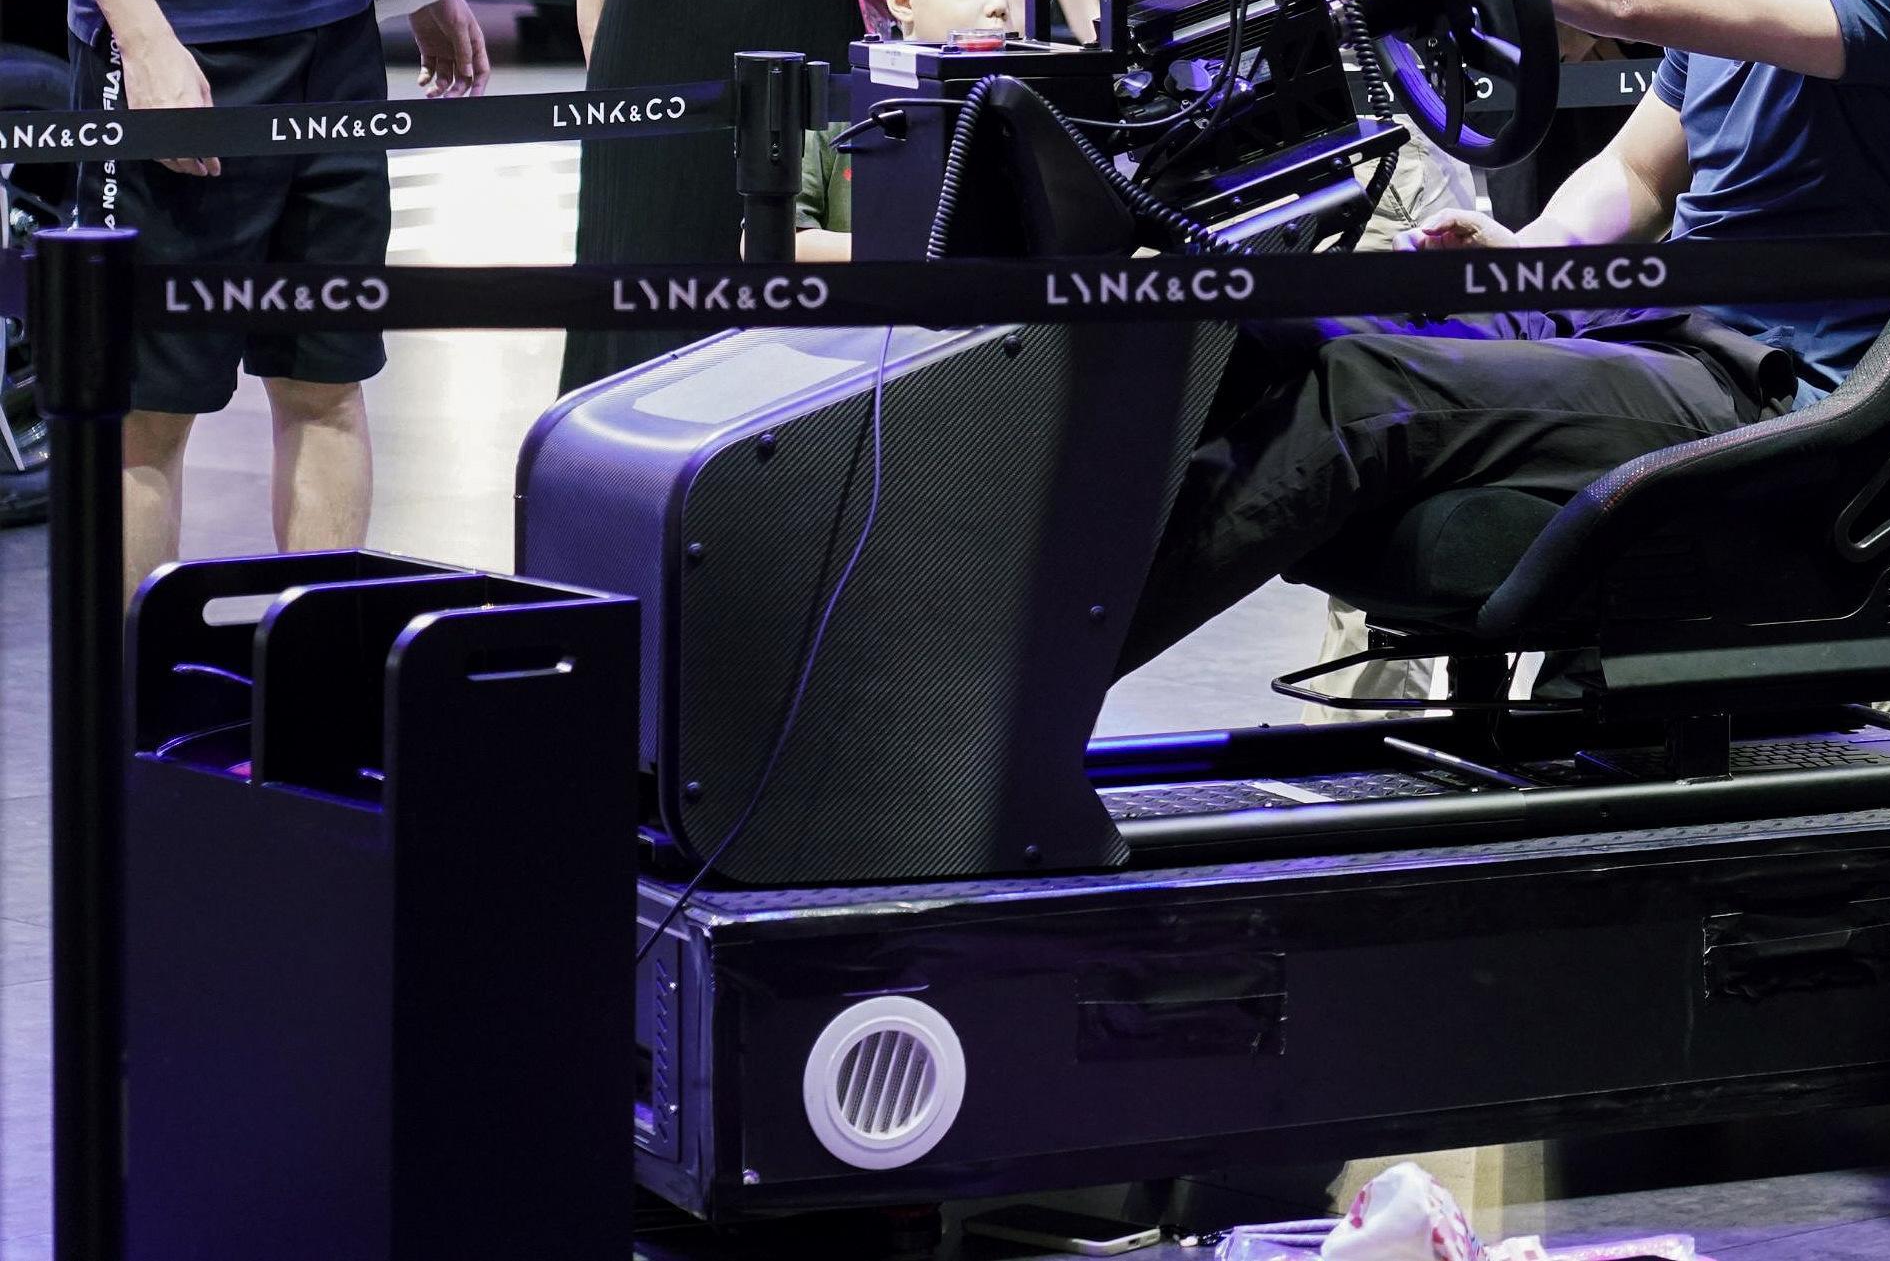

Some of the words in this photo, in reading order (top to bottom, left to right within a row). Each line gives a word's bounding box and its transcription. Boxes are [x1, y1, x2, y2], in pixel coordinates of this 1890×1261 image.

[272, 111, 412, 141] LYNK&CO
[553, 96, 686, 128] LYNK&CO
[0, 122, 124, 149] NK&CO
[1046, 268, 1254, 304] LYNK&CO
[1465, 256, 1667, 294] LYNK&CO
[167, 278, 389, 312] LYNK&CO
[614, 277, 828, 311] LYNK&CO
